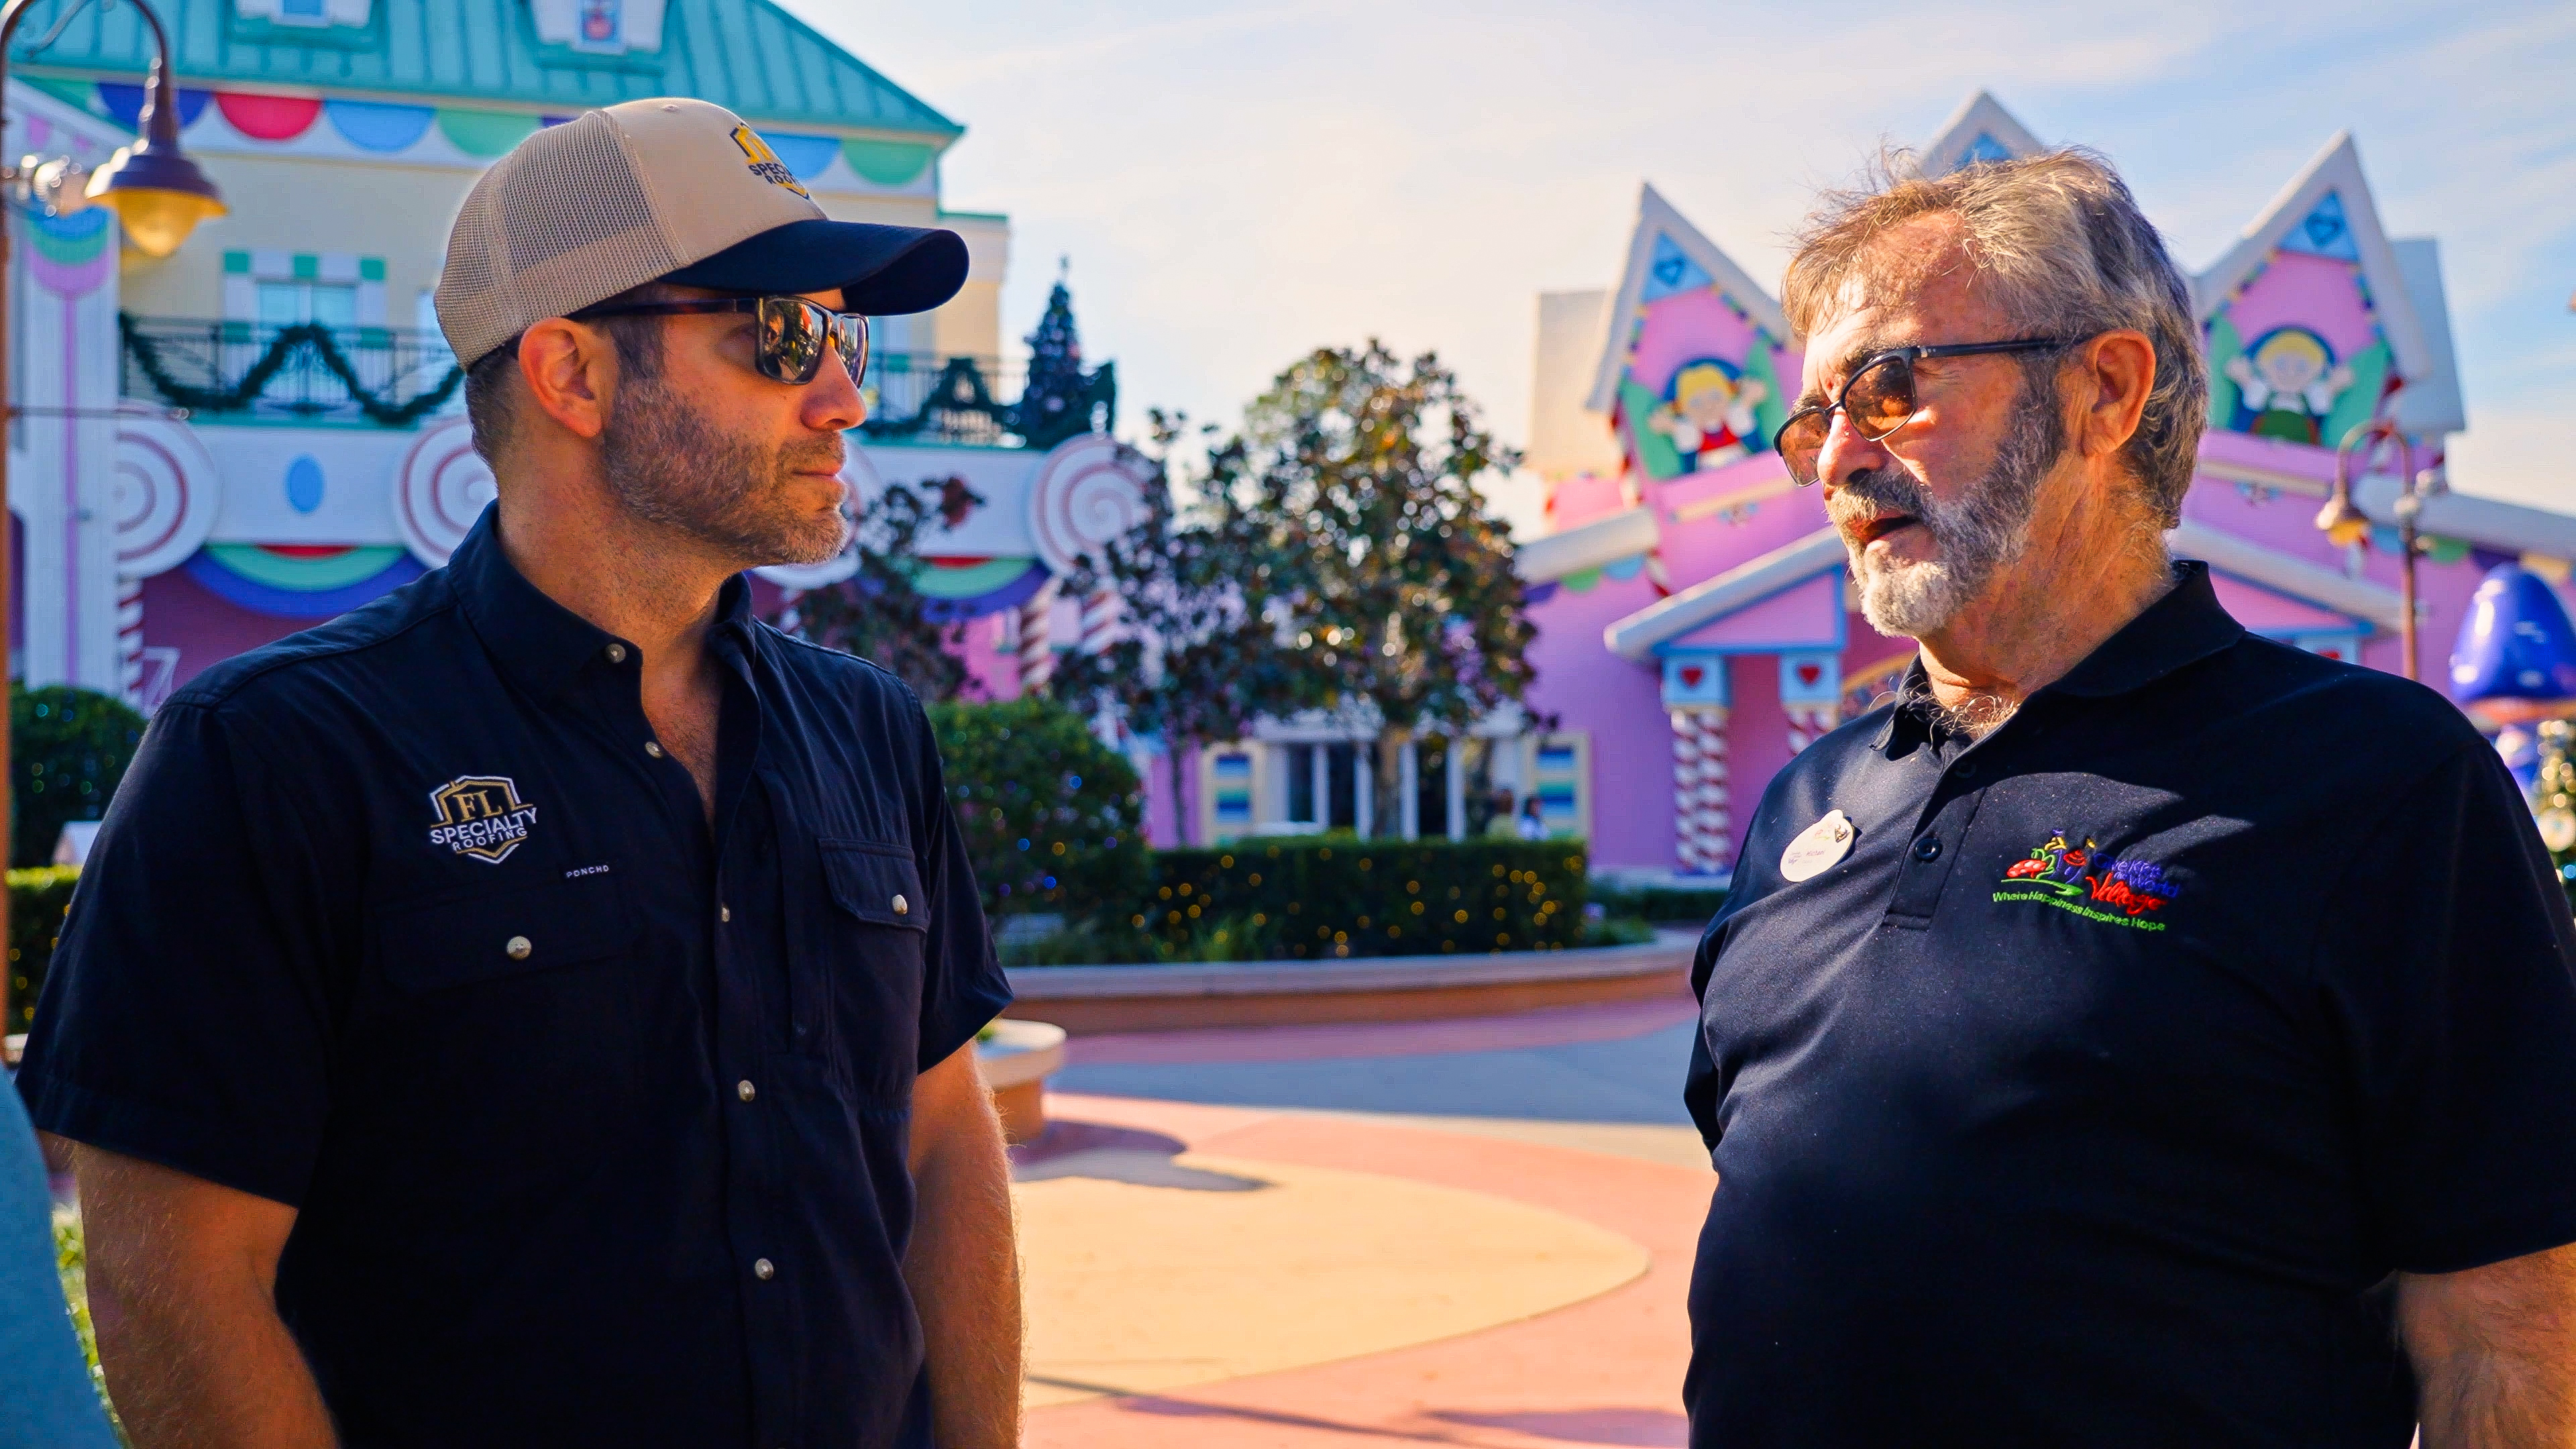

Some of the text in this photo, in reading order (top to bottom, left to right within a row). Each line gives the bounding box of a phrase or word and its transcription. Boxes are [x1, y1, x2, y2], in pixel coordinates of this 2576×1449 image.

[452, 790, 503, 822] FL
[430, 807, 537, 844] SPECIALTY
[451, 827, 528, 851] ROOFING
[566, 865, 609, 878] PONCHO
[2085, 871, 2168, 915] Village
[1993, 891, 2166, 932] Where Happiness Inspires Hope
